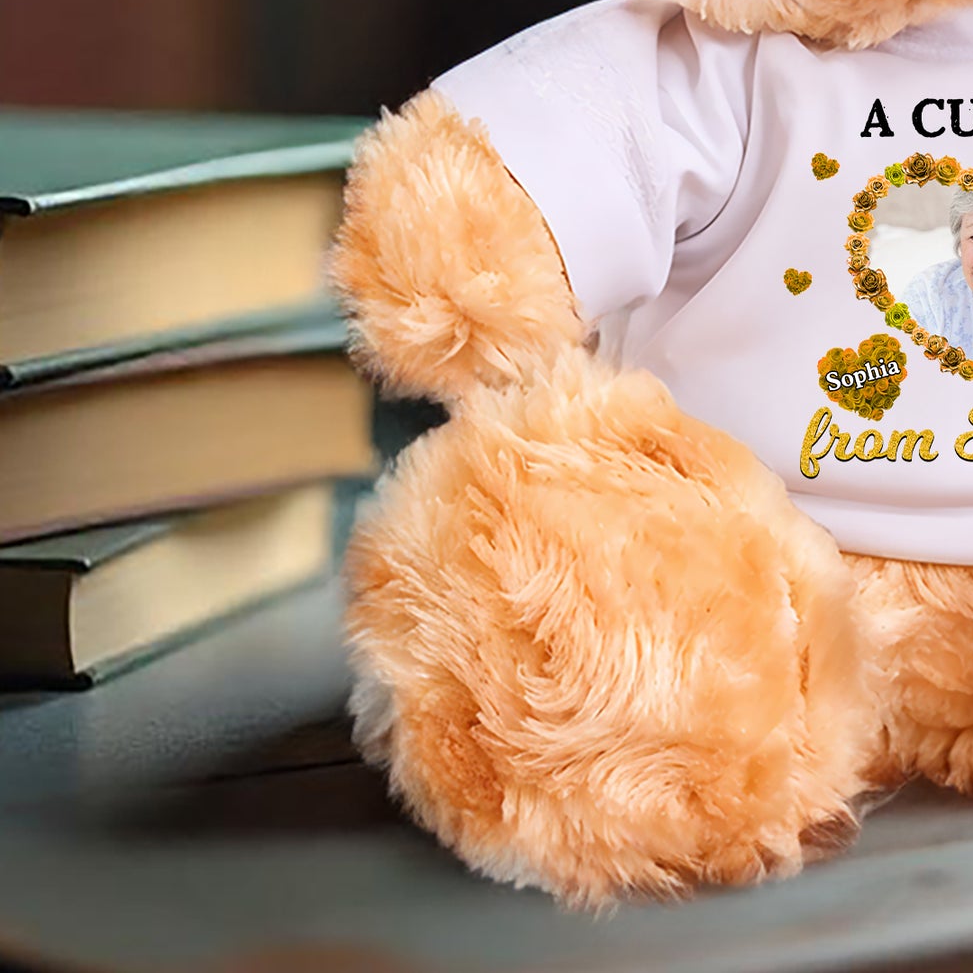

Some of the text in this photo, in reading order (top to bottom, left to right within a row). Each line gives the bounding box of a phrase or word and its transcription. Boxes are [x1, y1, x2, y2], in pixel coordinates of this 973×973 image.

[860, 98, 895, 138] A
[825, 358, 901, 391] Sophia
[799, 406, 939, 479] from
